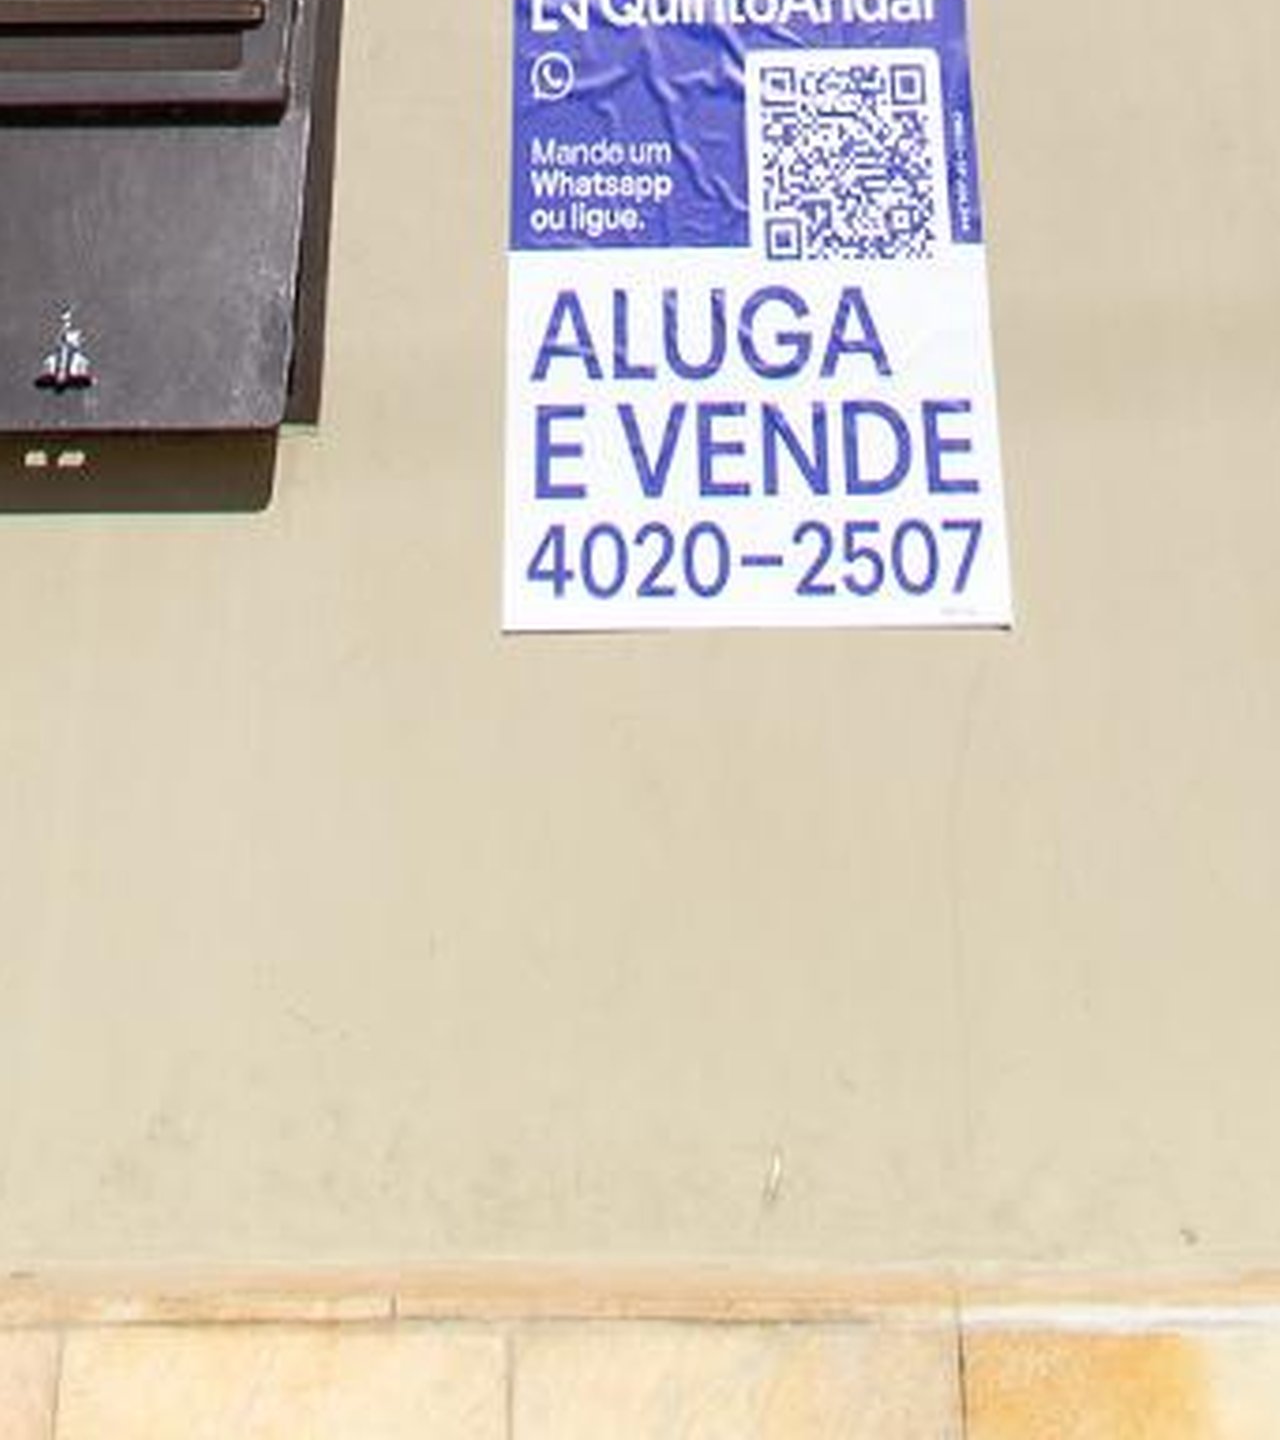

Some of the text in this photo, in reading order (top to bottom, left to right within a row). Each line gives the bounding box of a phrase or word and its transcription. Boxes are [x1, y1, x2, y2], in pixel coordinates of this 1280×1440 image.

[629, 140, 673, 166] um
[530, 168, 674, 204] Whatsapp
[530, 201, 646, 237] ou ligue.
[530, 284, 894, 382] ALUGA
[533, 398, 981, 500] E VENDE
[526, 518, 984, 600] 4020-2507
